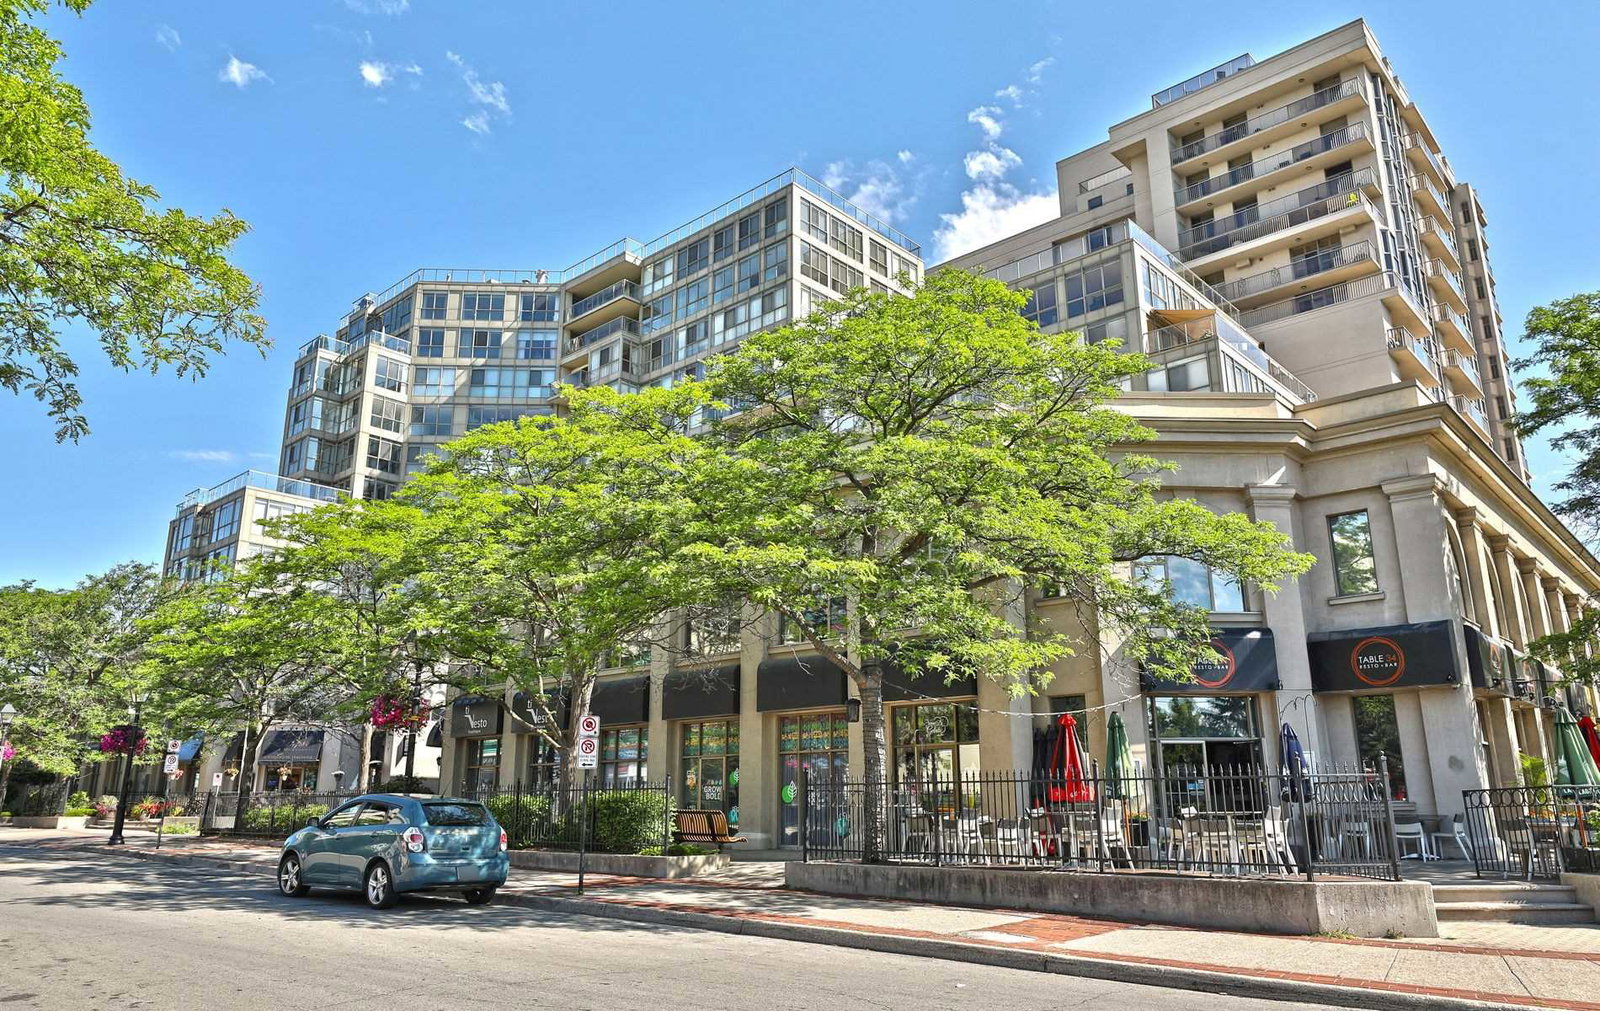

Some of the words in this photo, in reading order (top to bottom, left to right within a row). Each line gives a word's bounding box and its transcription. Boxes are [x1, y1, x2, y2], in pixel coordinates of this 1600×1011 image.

[1358, 655, 1384, 664] TABLE
[464, 713, 488, 729] Vesto
[703, 785, 723, 794] GROW
[705, 792, 721, 801] BOLD
